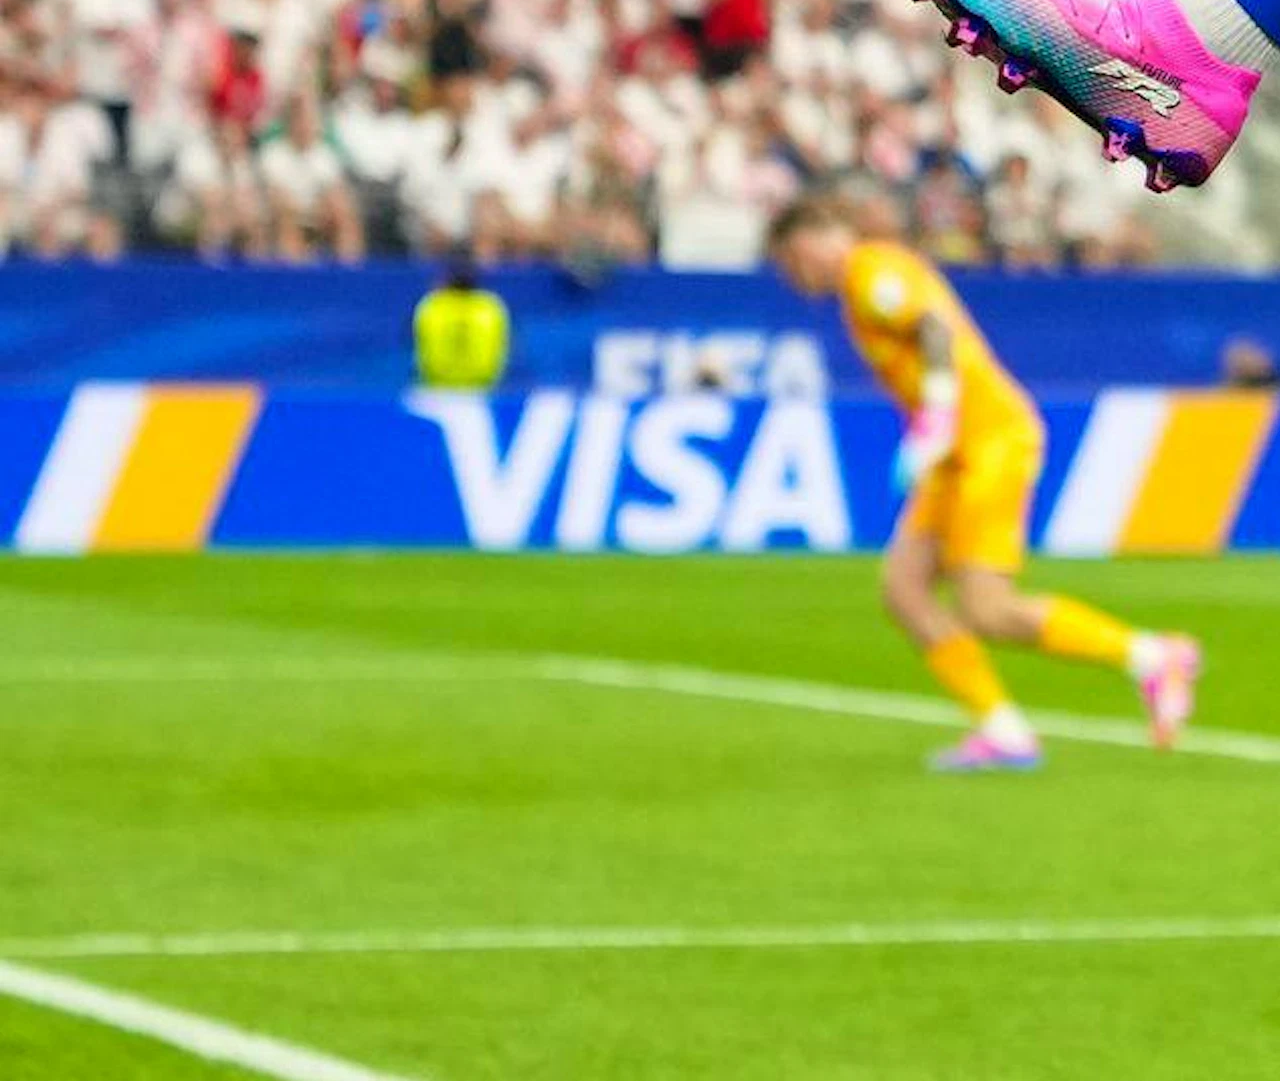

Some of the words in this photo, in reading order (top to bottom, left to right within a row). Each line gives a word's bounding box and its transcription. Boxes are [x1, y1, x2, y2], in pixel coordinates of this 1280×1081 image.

[1141, 62, 1188, 91] FUTURE
[592, 330, 828, 399] FIFA
[408, 391, 851, 553] VISA
